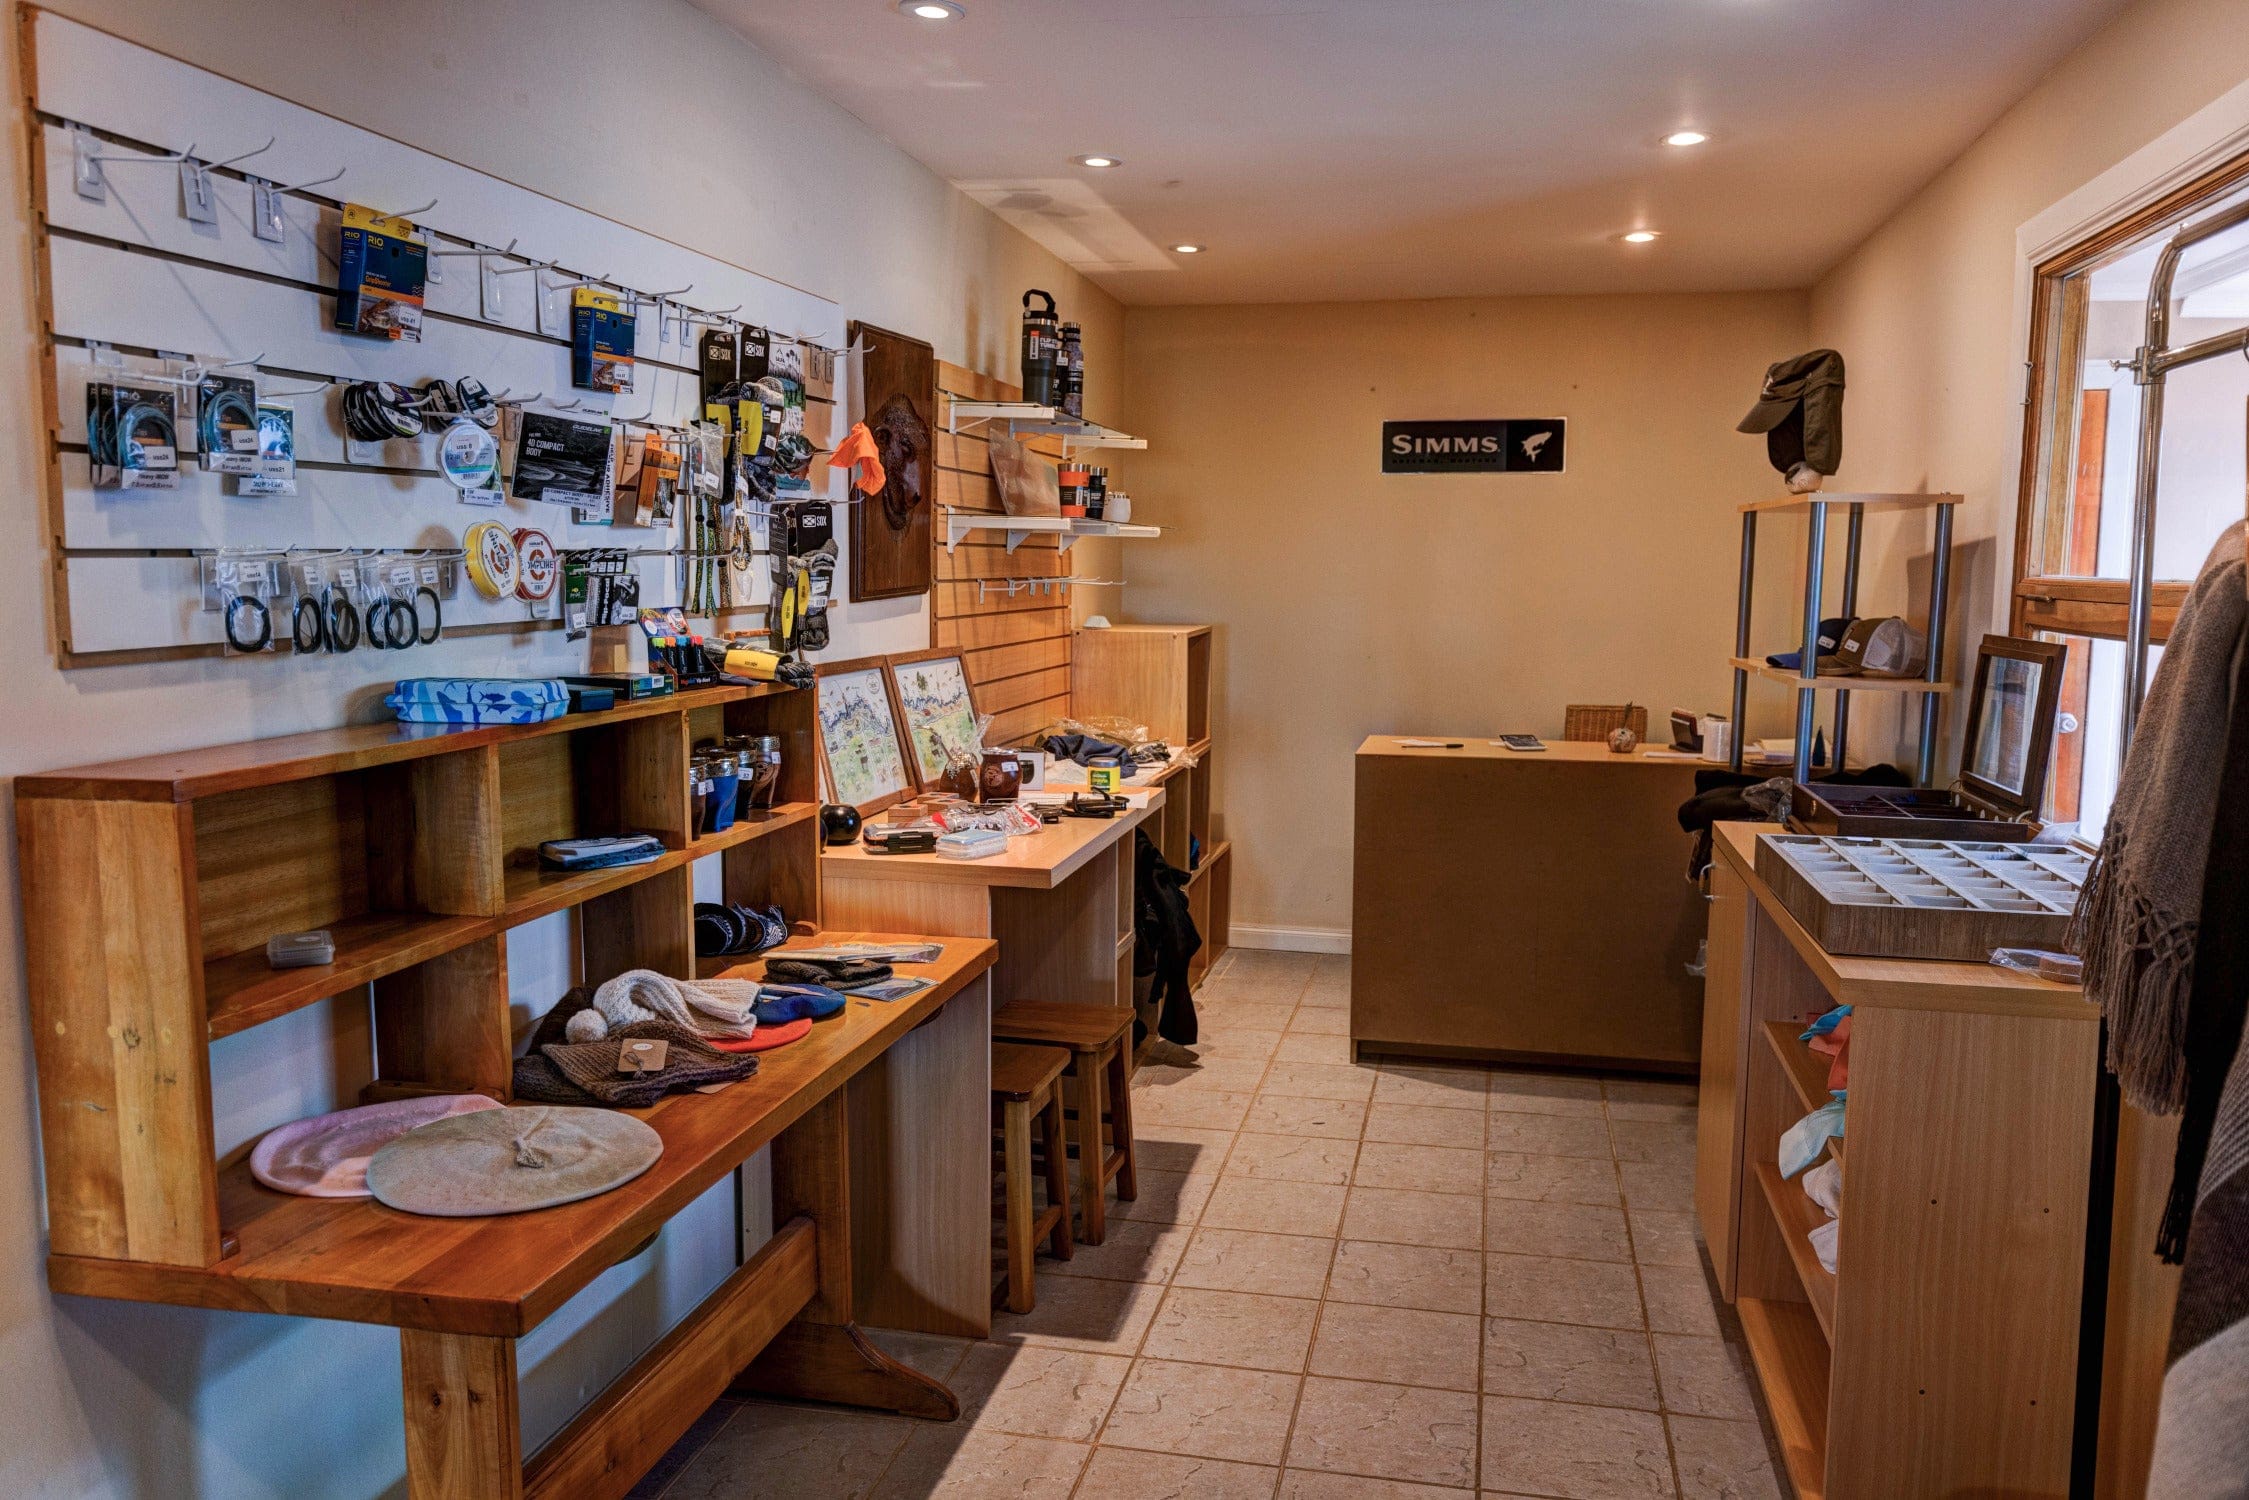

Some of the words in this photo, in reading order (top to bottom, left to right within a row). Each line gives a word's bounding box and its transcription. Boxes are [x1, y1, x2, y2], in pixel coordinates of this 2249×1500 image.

[344, 231, 360, 239] RIO
[367, 235, 384, 247] RIO
[595, 312, 608, 321] RIO
[536, 440, 565, 452] COMPACT
[1391, 434, 1499, 454] SIMMS
[525, 447, 542, 457] BODY
[816, 515, 827, 527] SOX
